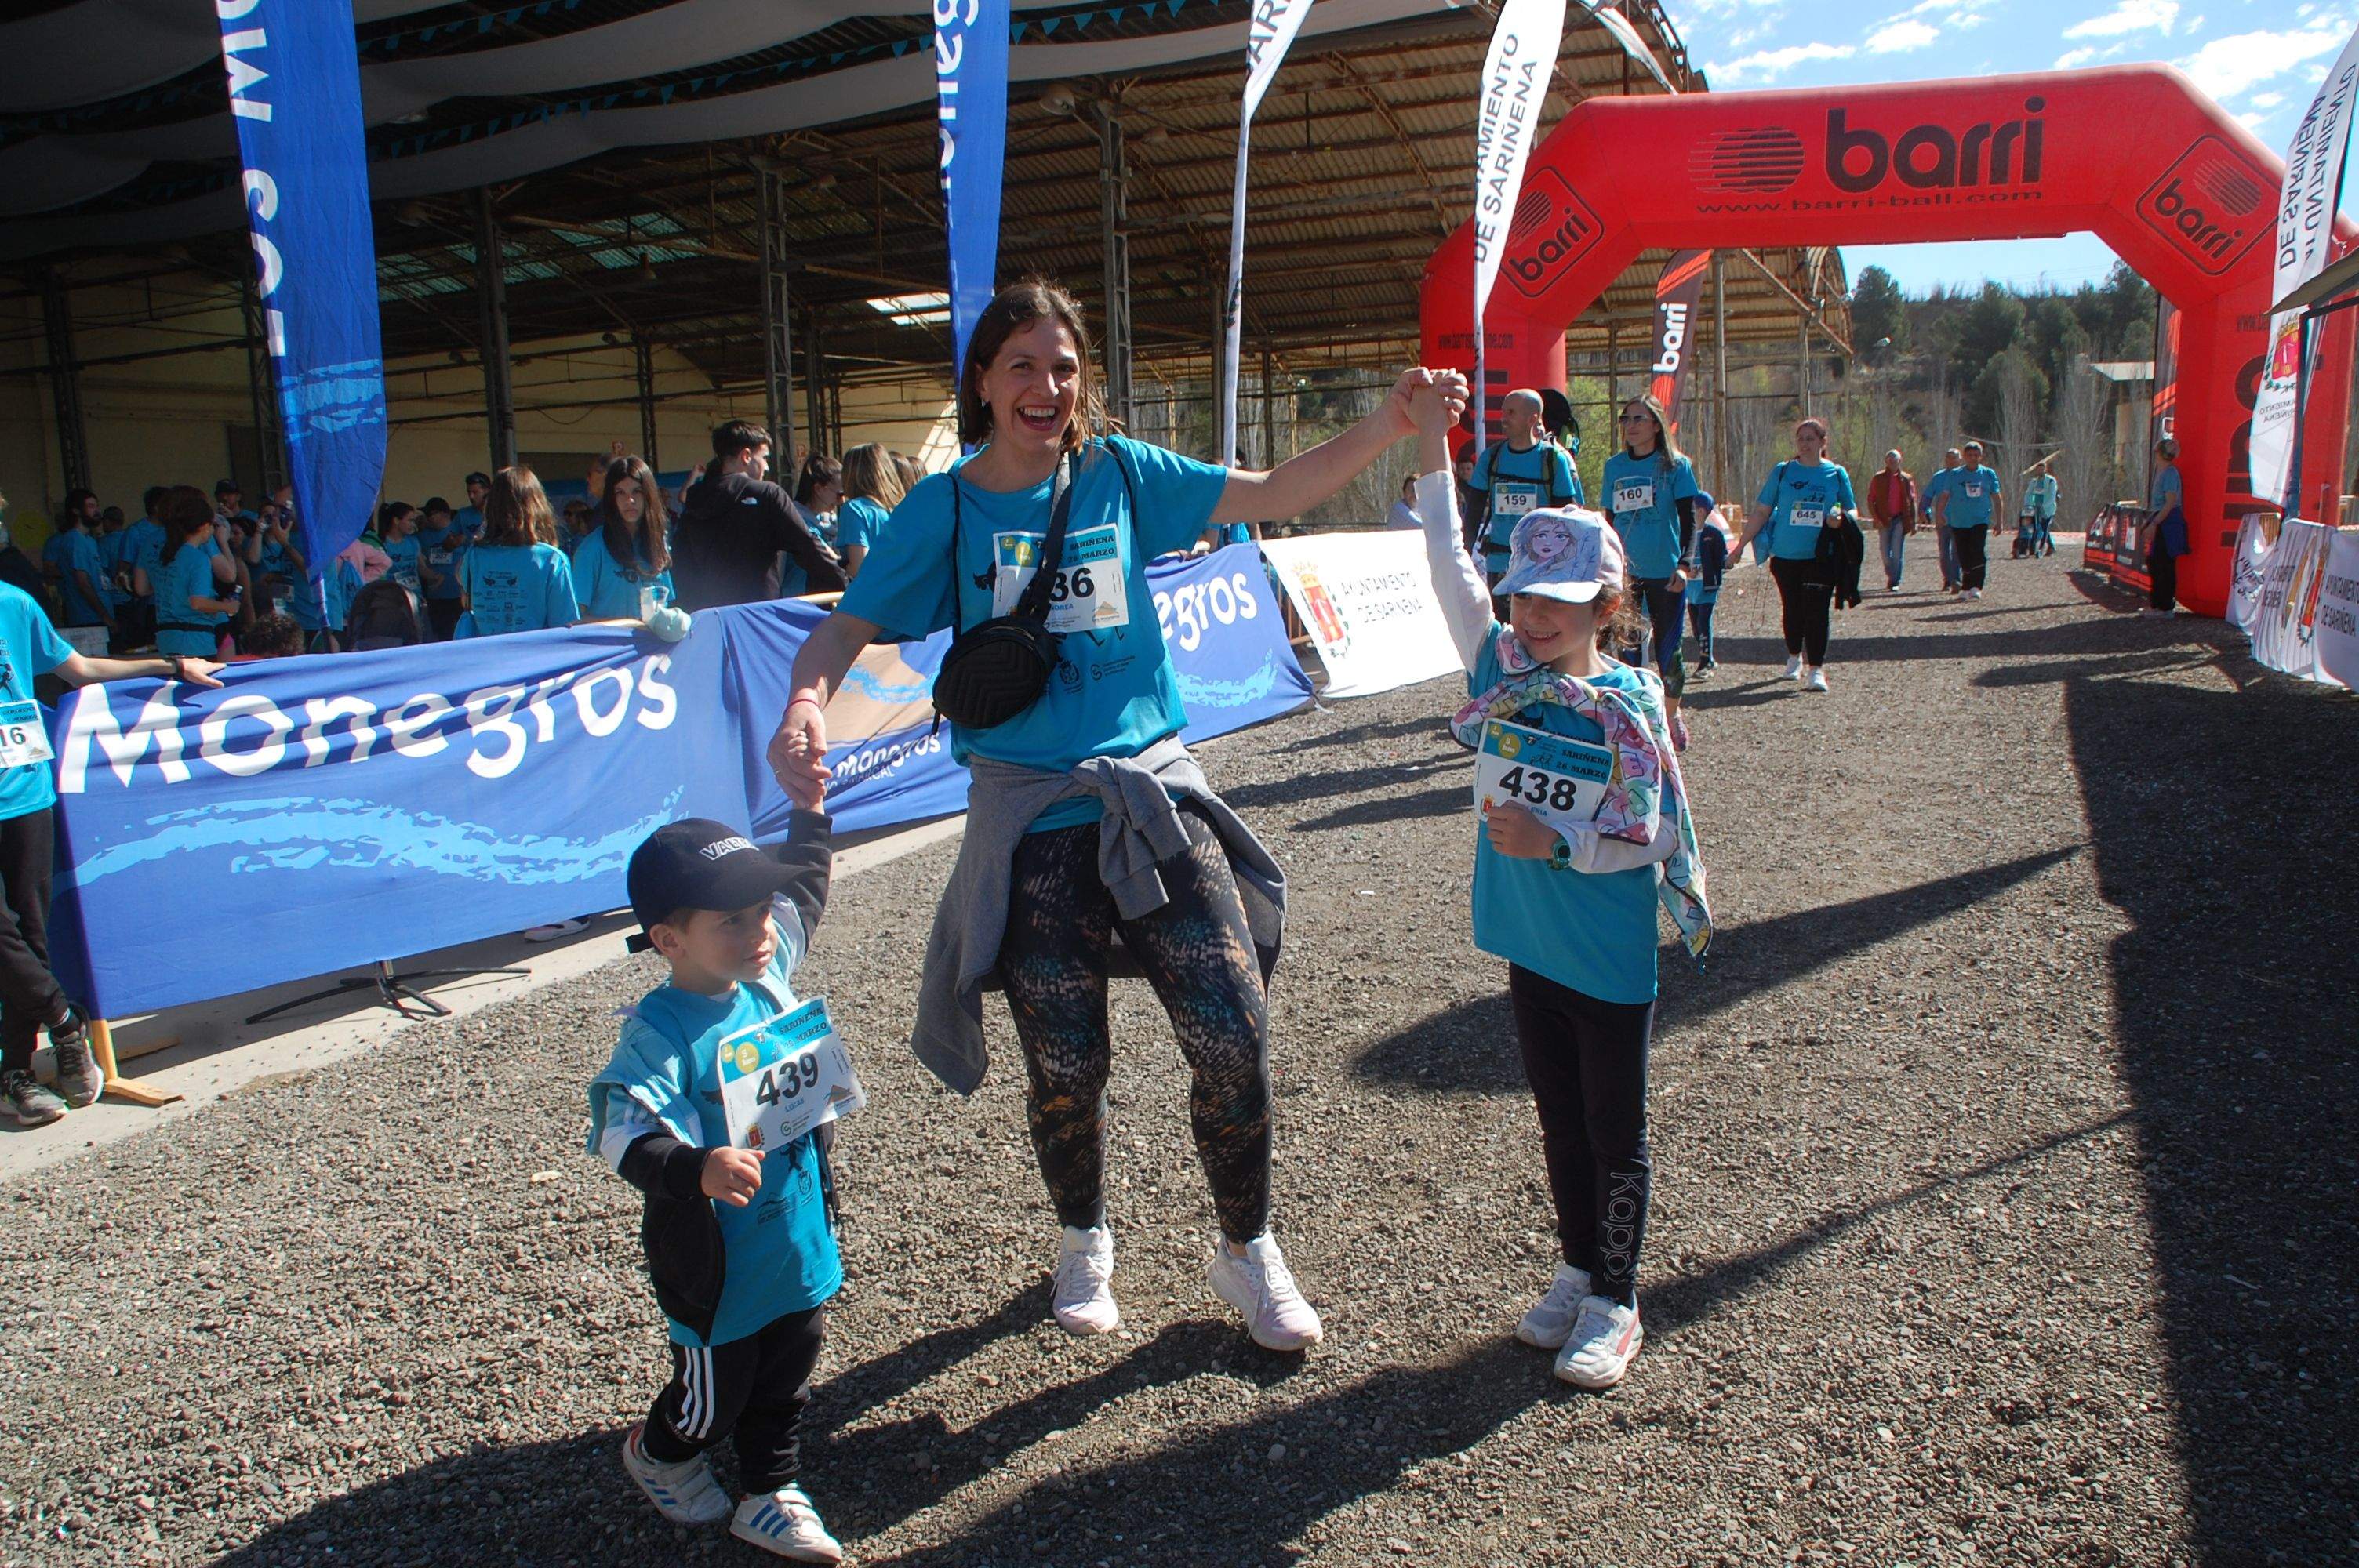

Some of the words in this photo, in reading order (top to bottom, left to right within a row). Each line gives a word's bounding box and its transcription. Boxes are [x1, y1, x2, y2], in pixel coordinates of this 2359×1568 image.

[1483, 60, 1537, 215] SARIÑENA
[1826, 95, 2046, 194] barri
[1696, 191, 2043, 214] www.barri-ball.com
[2154, 176, 2244, 260] barri
[1508, 206, 1590, 281] barri
[1652, 303, 1688, 372] barri
[1503, 495, 1528, 506] 159
[1619, 488, 1643, 502] 160
[1797, 510, 1816, 519] 645
[1070, 535, 1114, 550] SARIÑENA
[1081, 548, 1116, 560] MARZO
[57, 652, 678, 794] Monegros
[1499, 765, 1577, 811] 438
[1570, 764, 1607, 779] MARZO
[795, 1022, 827, 1042] MARZO
[756, 1051, 819, 1107] 439
